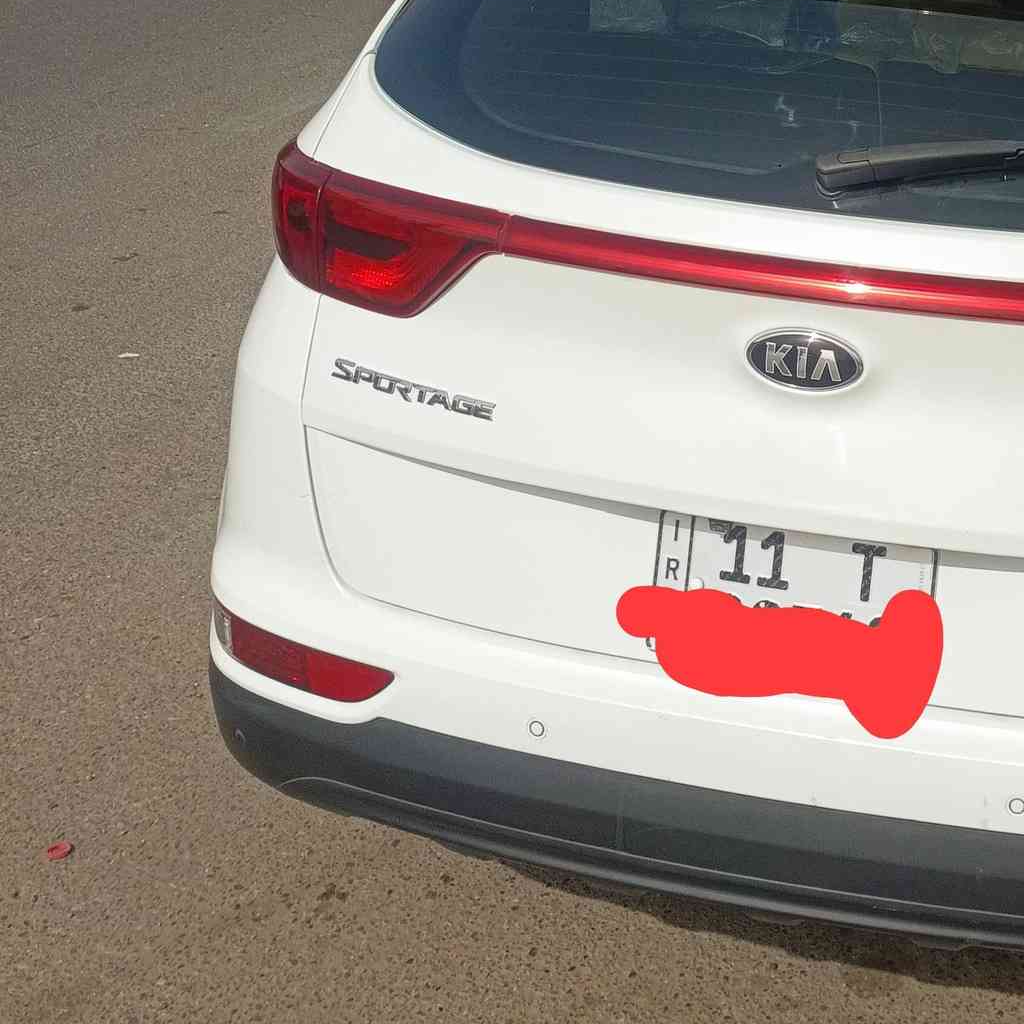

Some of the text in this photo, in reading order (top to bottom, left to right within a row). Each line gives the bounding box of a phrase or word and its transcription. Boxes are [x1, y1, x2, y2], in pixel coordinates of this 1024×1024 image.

[331, 358, 497, 422] SPORTAGE
[765, 342, 842, 382] KIA
[719, 525, 789, 590] 11
[852, 542, 887, 602] T
